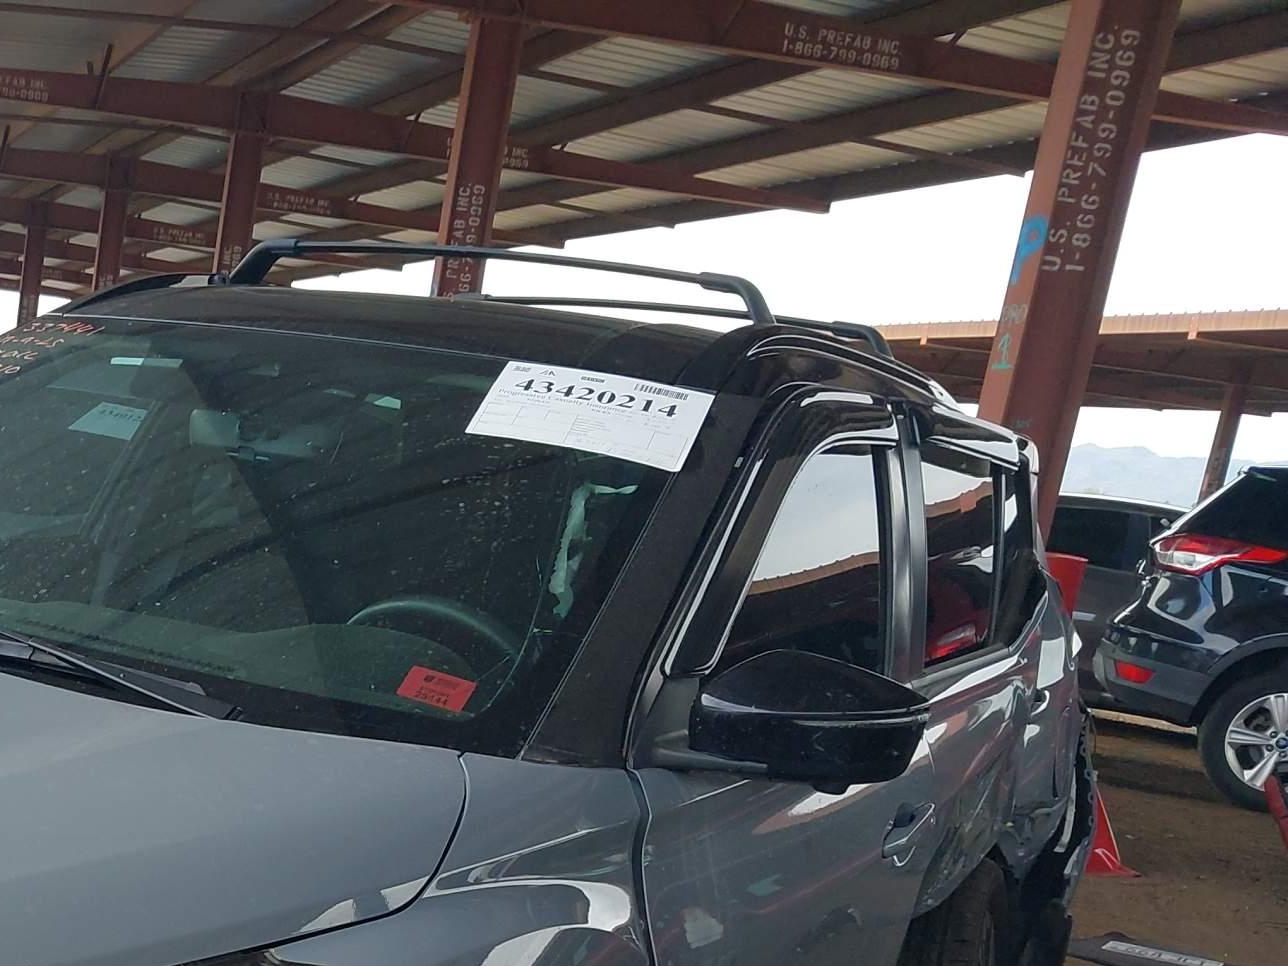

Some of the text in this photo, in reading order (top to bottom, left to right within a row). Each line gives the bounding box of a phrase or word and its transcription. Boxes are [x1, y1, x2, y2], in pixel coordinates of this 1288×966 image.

[782, 39, 900, 70] 1-866-799-0969
[784, 22, 810, 40] U.S.
[817, 29, 872, 49] PREFAB
[1041, 25, 1118, 272] U.S. PREFAB INC.
[1065, 28, 1142, 272] 1-866-799-0969
[446, 219, 466, 278] PRFAB
[458, 184, 486, 292] 66-79-0969
[515, 379, 678, 417] 43420214
